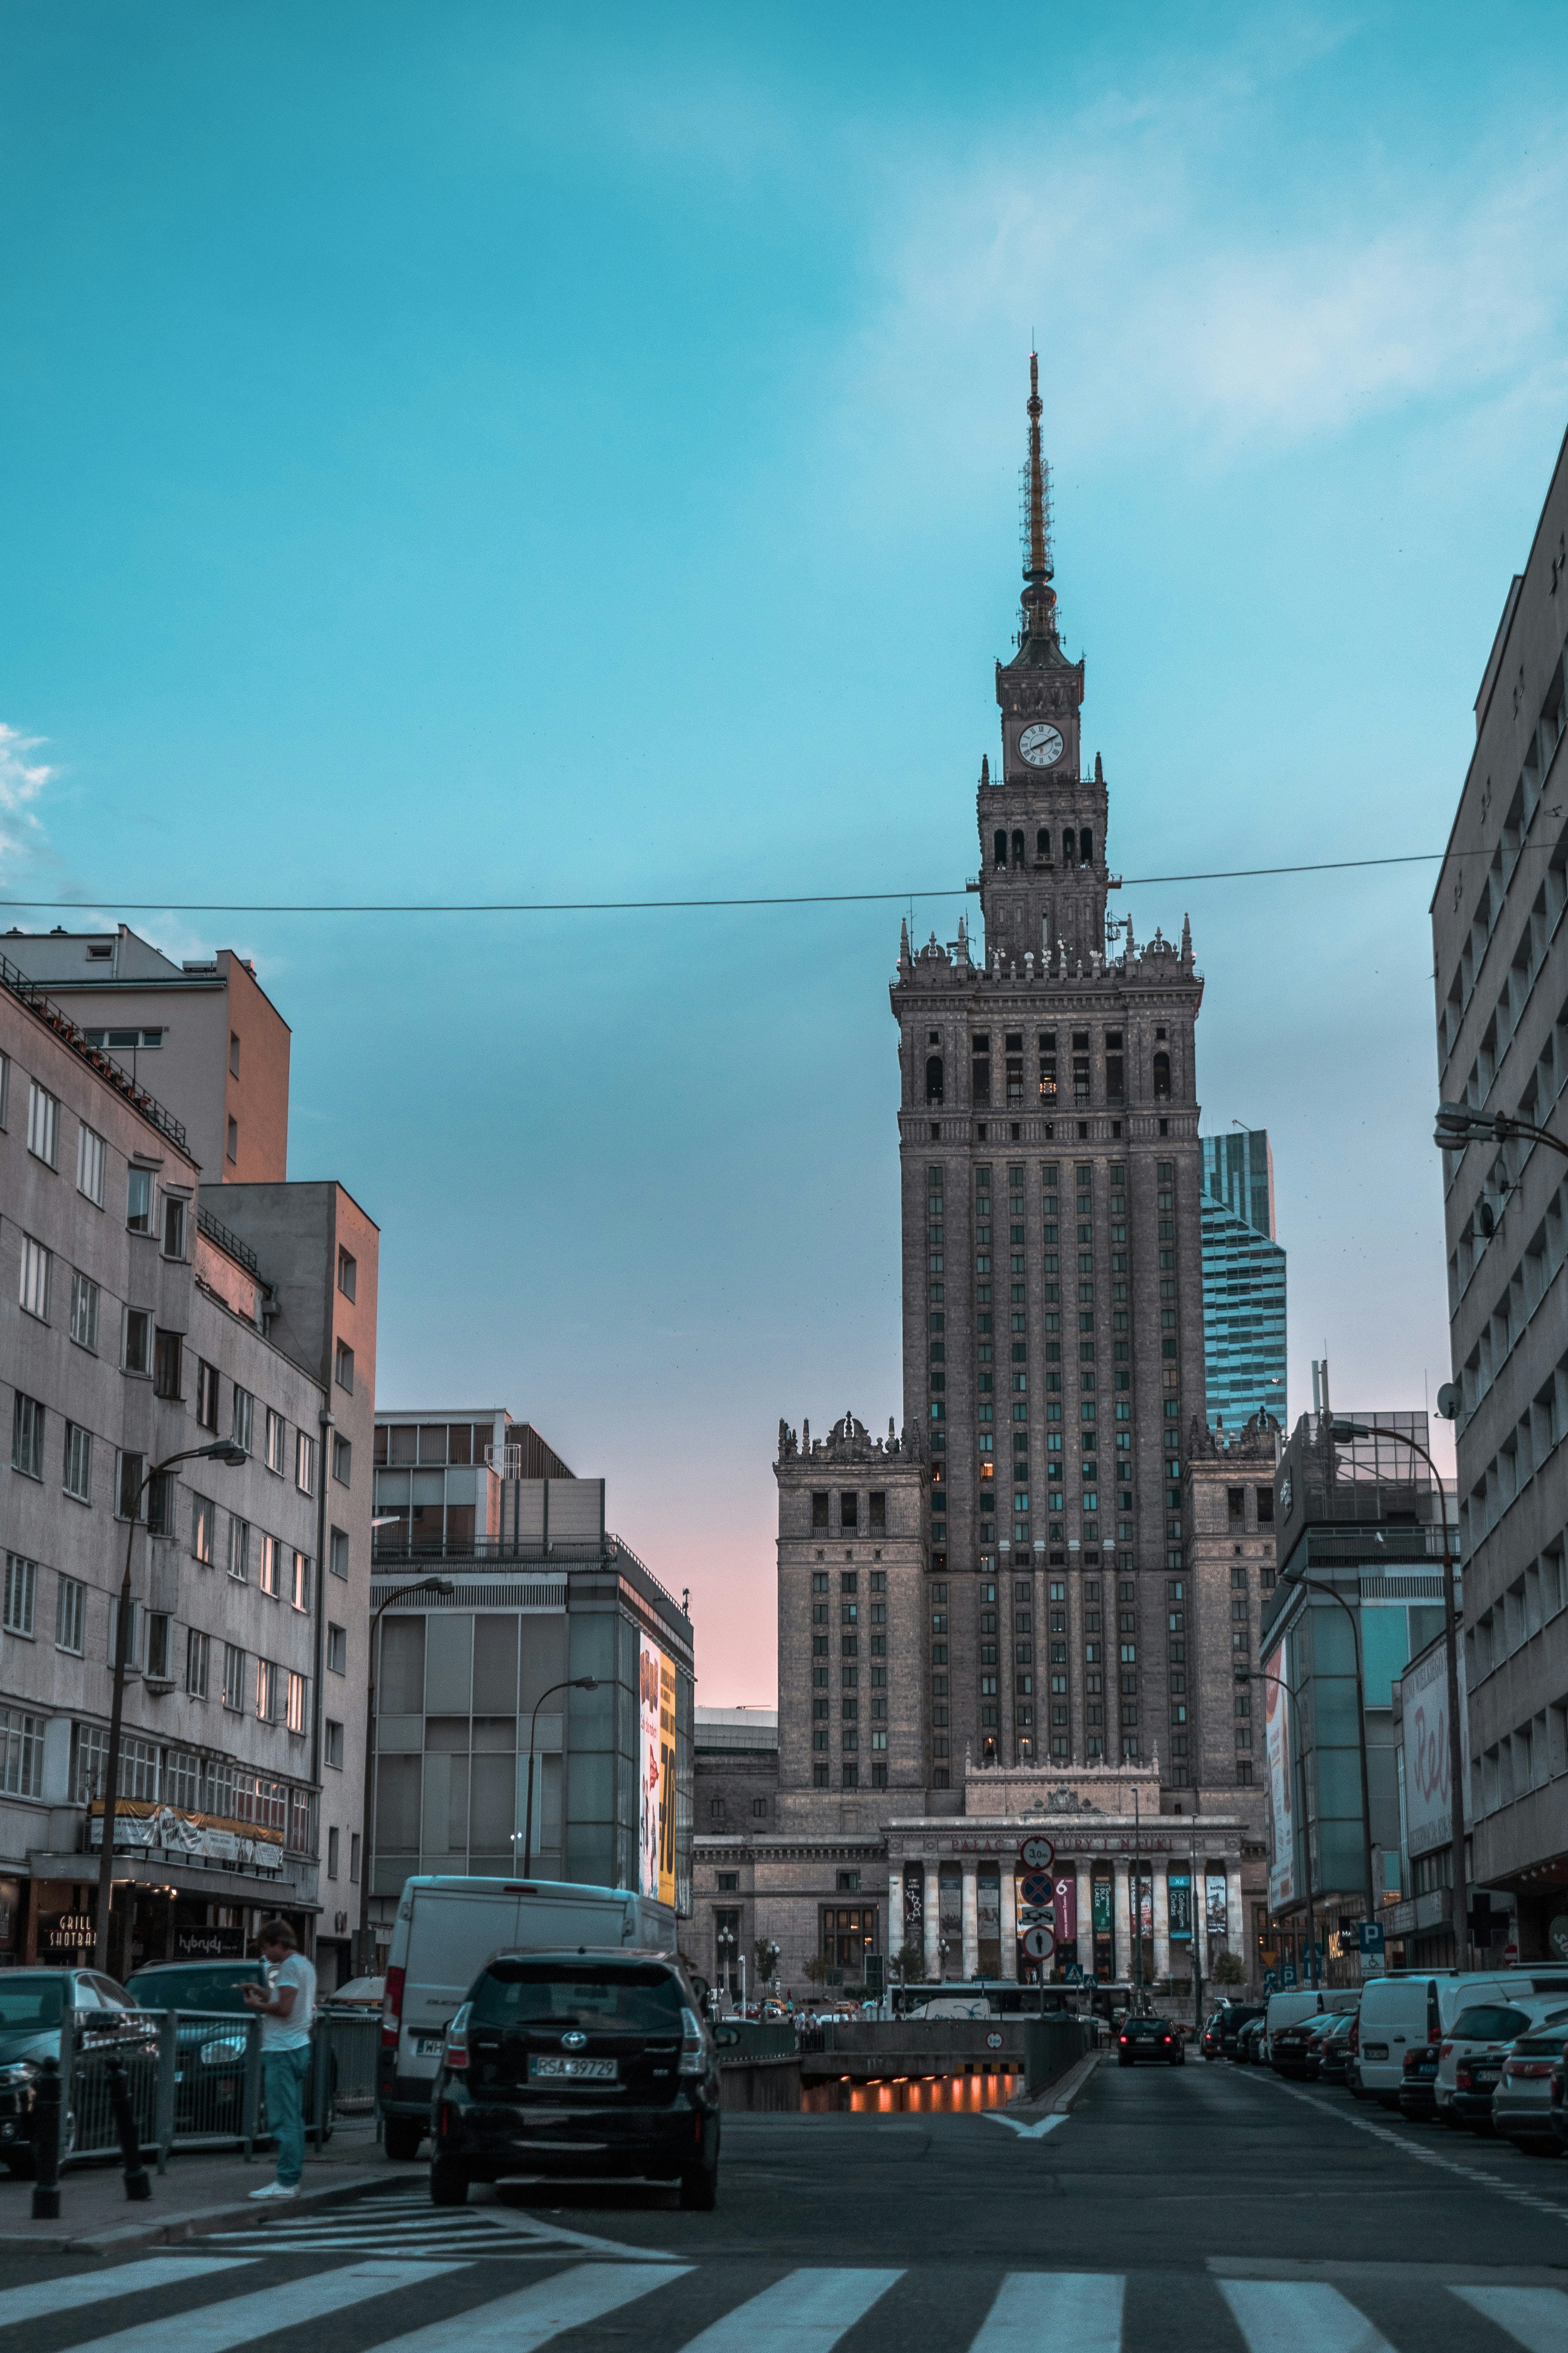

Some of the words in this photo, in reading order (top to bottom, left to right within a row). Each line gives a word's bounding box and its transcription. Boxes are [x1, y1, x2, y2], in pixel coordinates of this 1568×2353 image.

[952, 1839, 1004, 1851] PAŁAC
[1016, 1839, 1092, 1851] KTURY
[1103, 1839, 1107, 1850] I
[1029, 1848, 1047, 1858] 3,0m
[1056, 1880, 1067, 1895] 6
[1177, 1893, 1185, 1928] Collegium
[59, 1915, 91, 1930] GRILL
[1364, 1925, 1379, 1944] P
[539, 2059, 566, 2074] RSA
[570, 2060, 614, 2075] 39729
